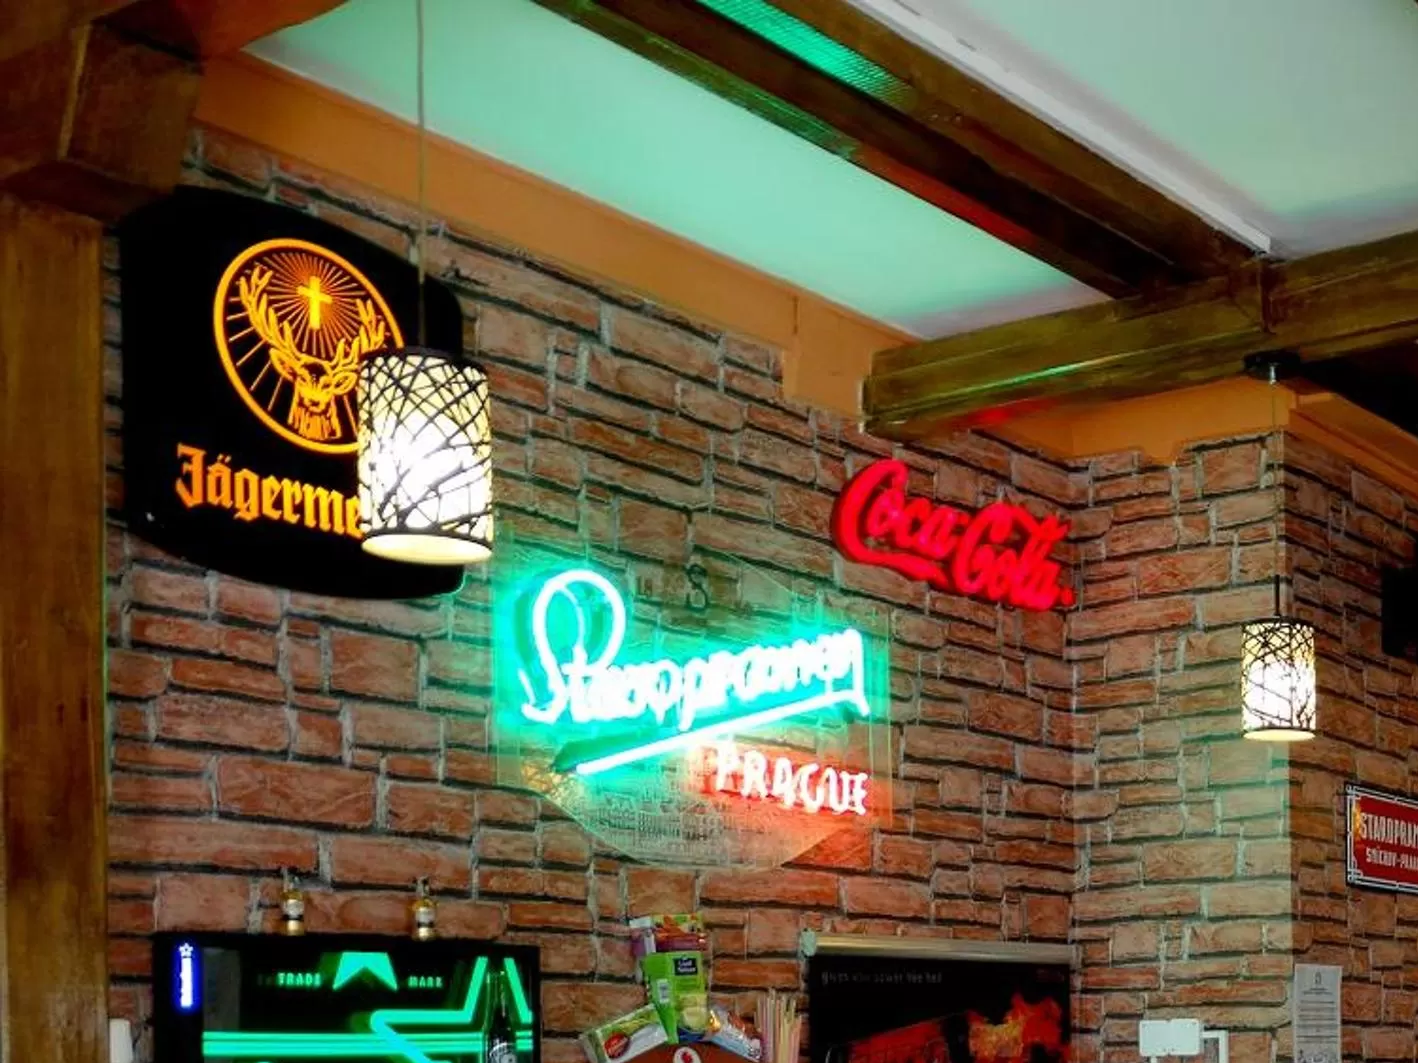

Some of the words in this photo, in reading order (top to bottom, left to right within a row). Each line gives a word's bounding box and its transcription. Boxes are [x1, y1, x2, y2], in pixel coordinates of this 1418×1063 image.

[174, 441, 364, 541] Jägerme
[715, 742, 869, 816] PRAGUE
[276, 971, 322, 986] TRADE
[408, 975, 443, 989] MARK
